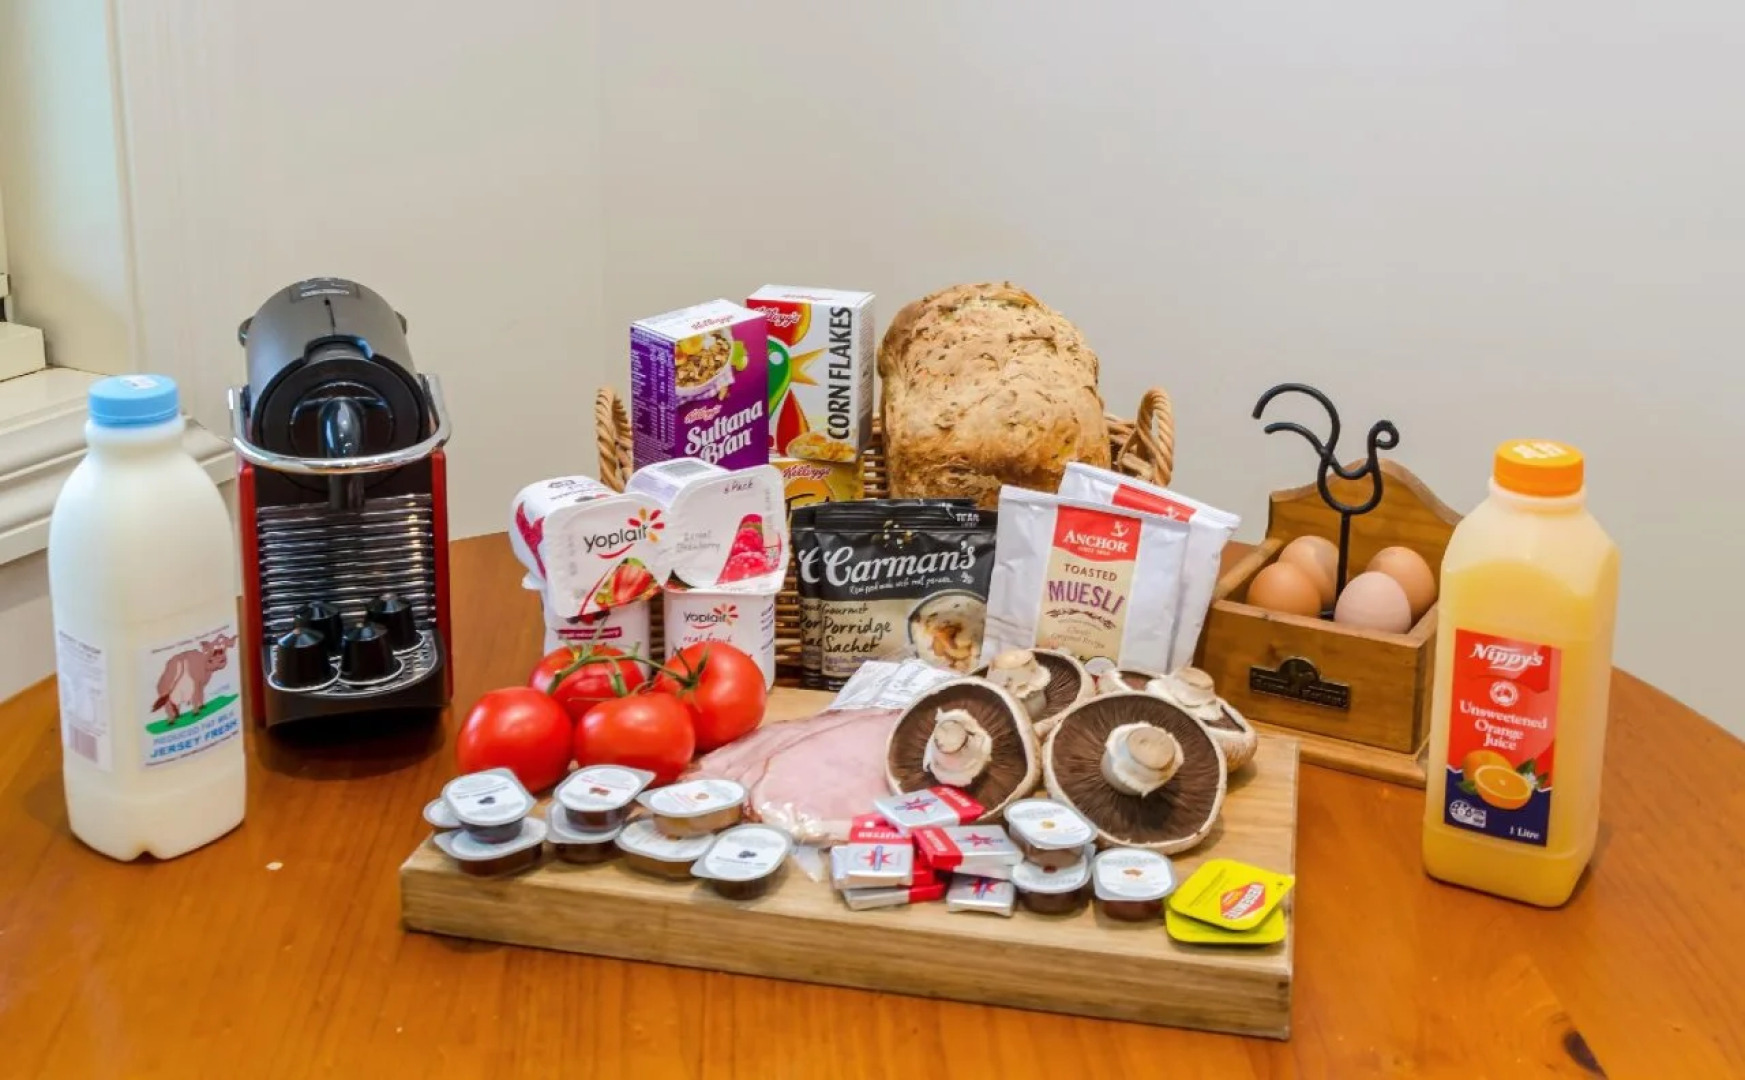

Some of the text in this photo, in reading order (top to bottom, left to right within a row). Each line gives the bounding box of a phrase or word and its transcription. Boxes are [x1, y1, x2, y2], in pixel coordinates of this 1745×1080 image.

[826, 305, 853, 440] CORN FLAKES
[685, 401, 763, 455] Sultana
[700, 428, 753, 466] Bran
[782, 463, 832, 480] Kellogg's
[583, 520, 649, 554] yoplait
[1062, 530, 1131, 553] ANCHOR
[822, 540, 976, 588] Carman's
[1063, 562, 1118, 582] TOASTED
[822, 603, 869, 614] Gourmet
[1046, 580, 1125, 616] MUESLI
[683, 610, 728, 625] yoplait
[822, 617, 892, 640] Porridge
[824, 634, 880, 654] Sachet
[1469, 643, 1545, 672] Nippy's
[1459, 700, 1549, 730] Unsweetened
[150, 719, 238, 759] JERSEY FRESH
[1474, 718, 1525, 741] Orange
[1483, 733, 1517, 751] Juice
[1517, 827, 1540, 840] Litre
